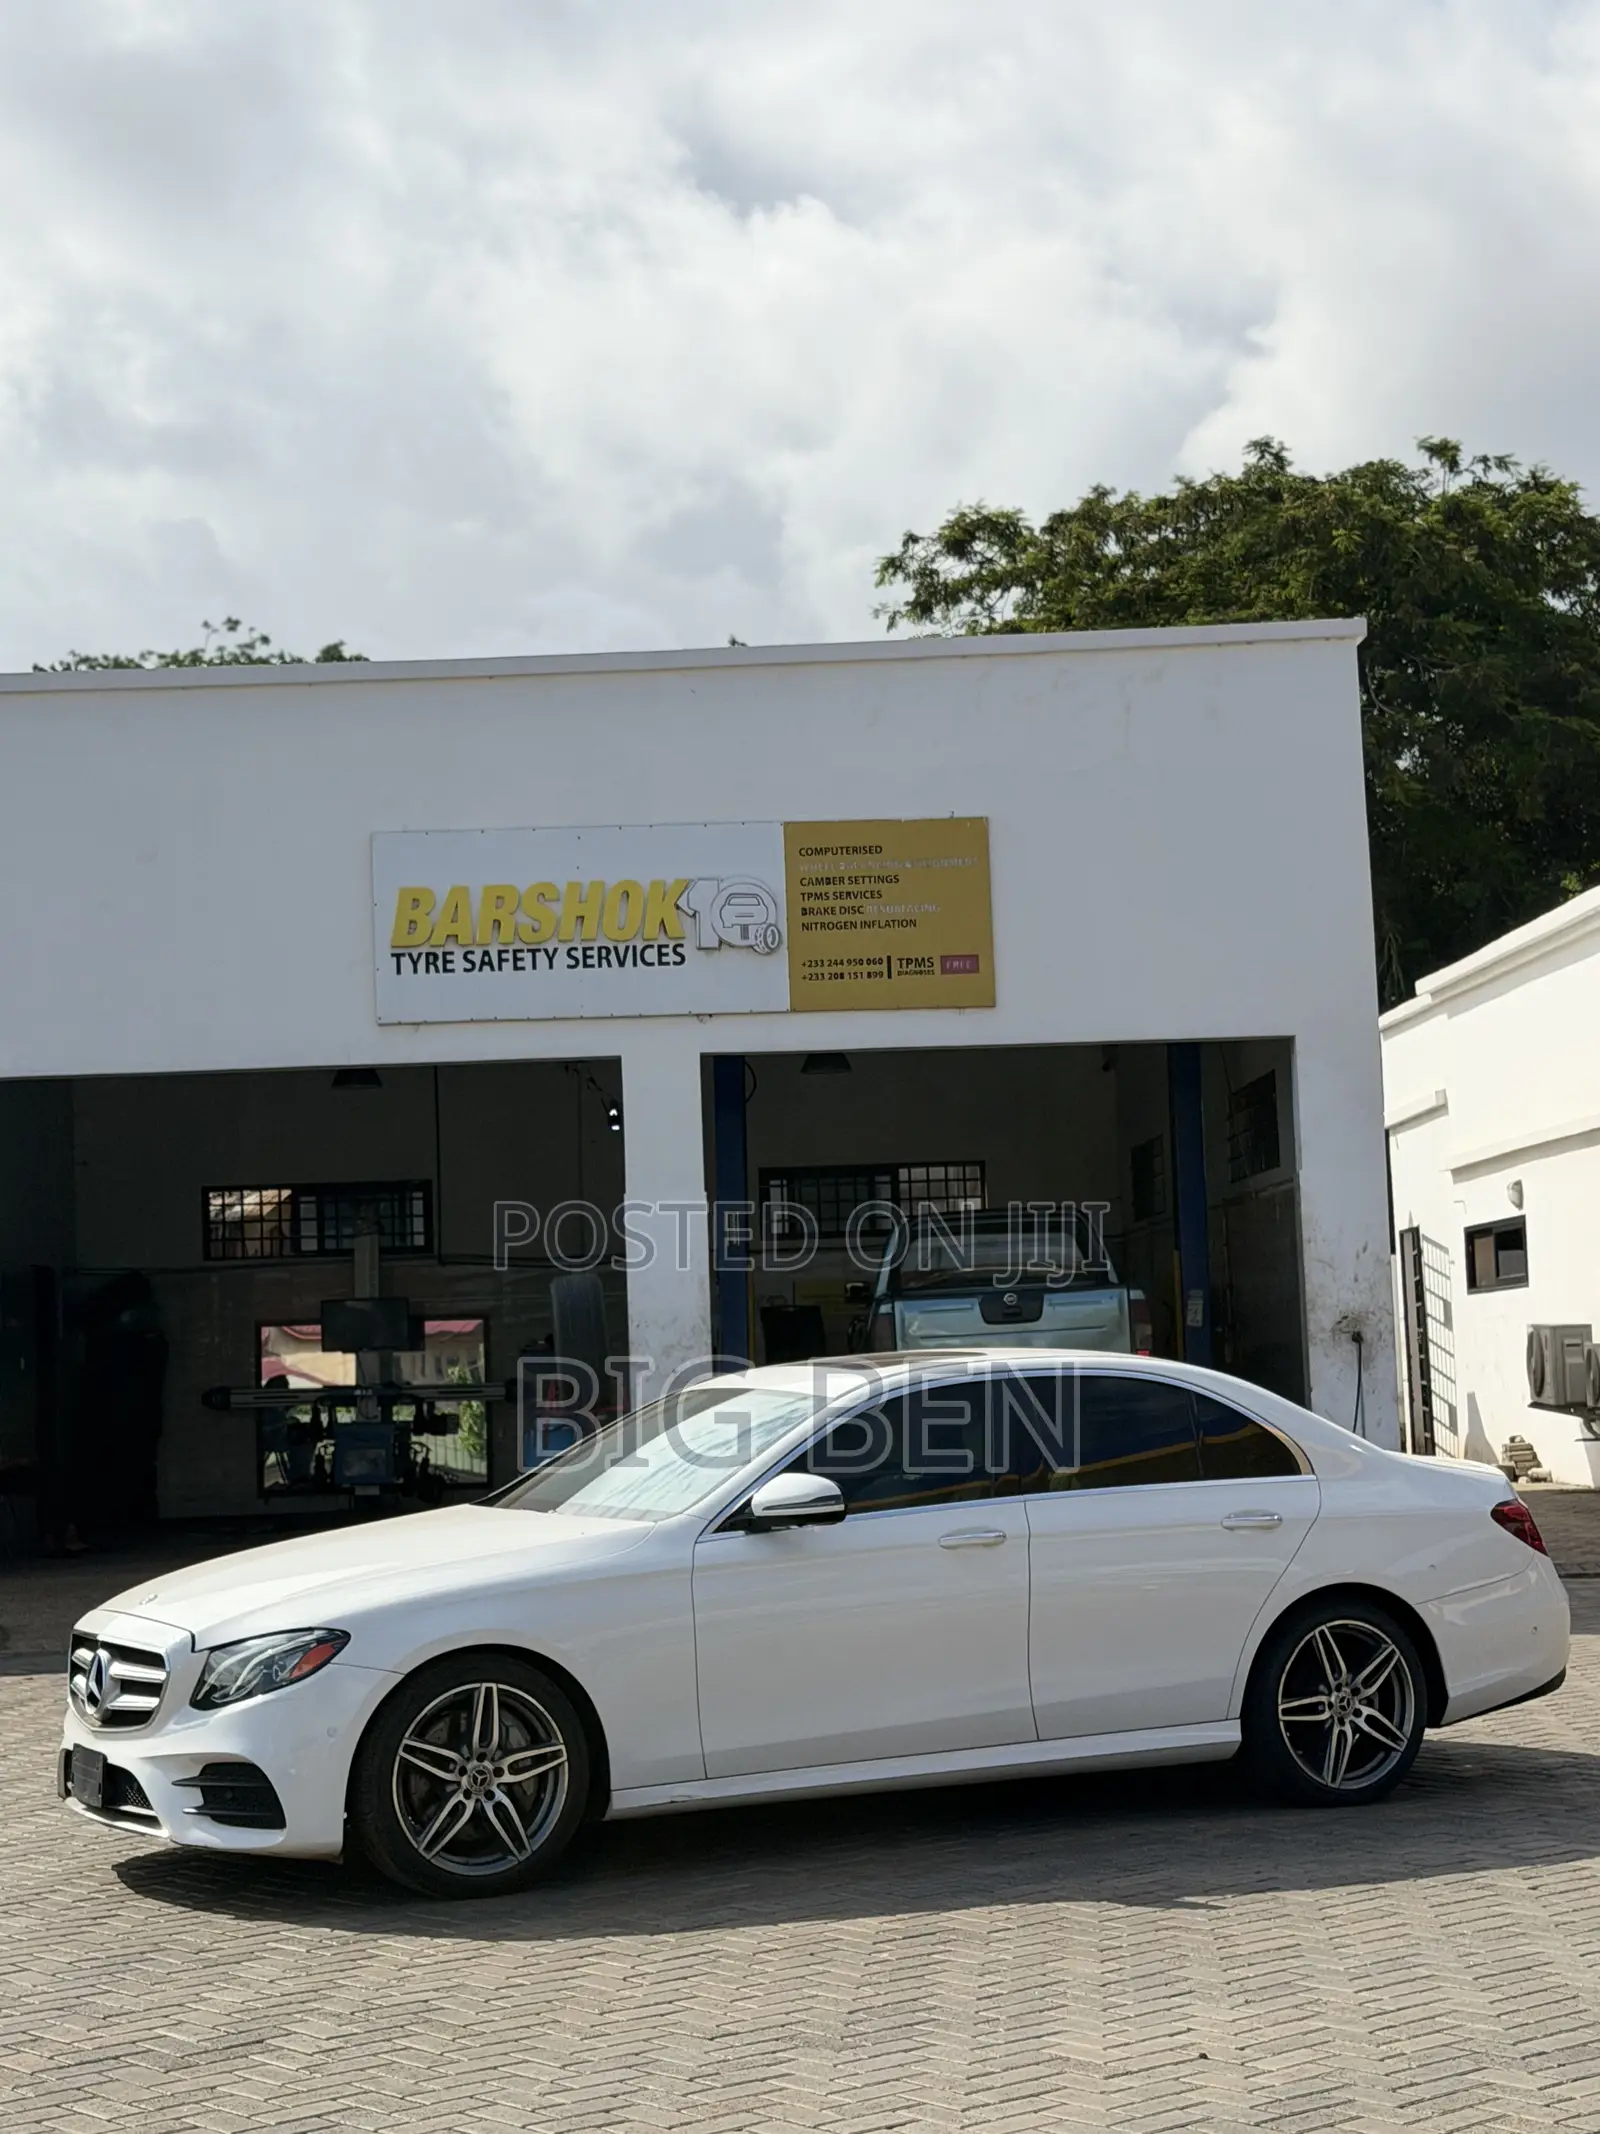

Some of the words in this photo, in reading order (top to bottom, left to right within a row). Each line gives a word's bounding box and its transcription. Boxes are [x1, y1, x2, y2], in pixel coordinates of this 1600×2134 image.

[799, 845, 883, 857] COMPUTERISED
[800, 876, 845, 887] CAMBER
[847, 874, 900, 885] SETTINGS
[801, 891, 830, 902] TPMS
[832, 890, 883, 901] SERVICES
[391, 878, 690, 948] BARSHOK
[801, 906, 837, 917] BRAKE
[838, 905, 865, 916] DISC
[801, 920, 858, 932] NITROGEN
[860, 918, 917, 930] INFLATION
[391, 951, 455, 975] TYRE
[463, 947, 559, 973] SAFETY
[566, 943, 686, 969] SERVICES
[801, 959, 825, 968] +233
[827, 958, 844, 968] 244
[846, 958, 864, 967] 950
[897, 956, 934, 969] TPMS
[801, 972, 825, 981] +233
[847, 971, 864, 980] 151
